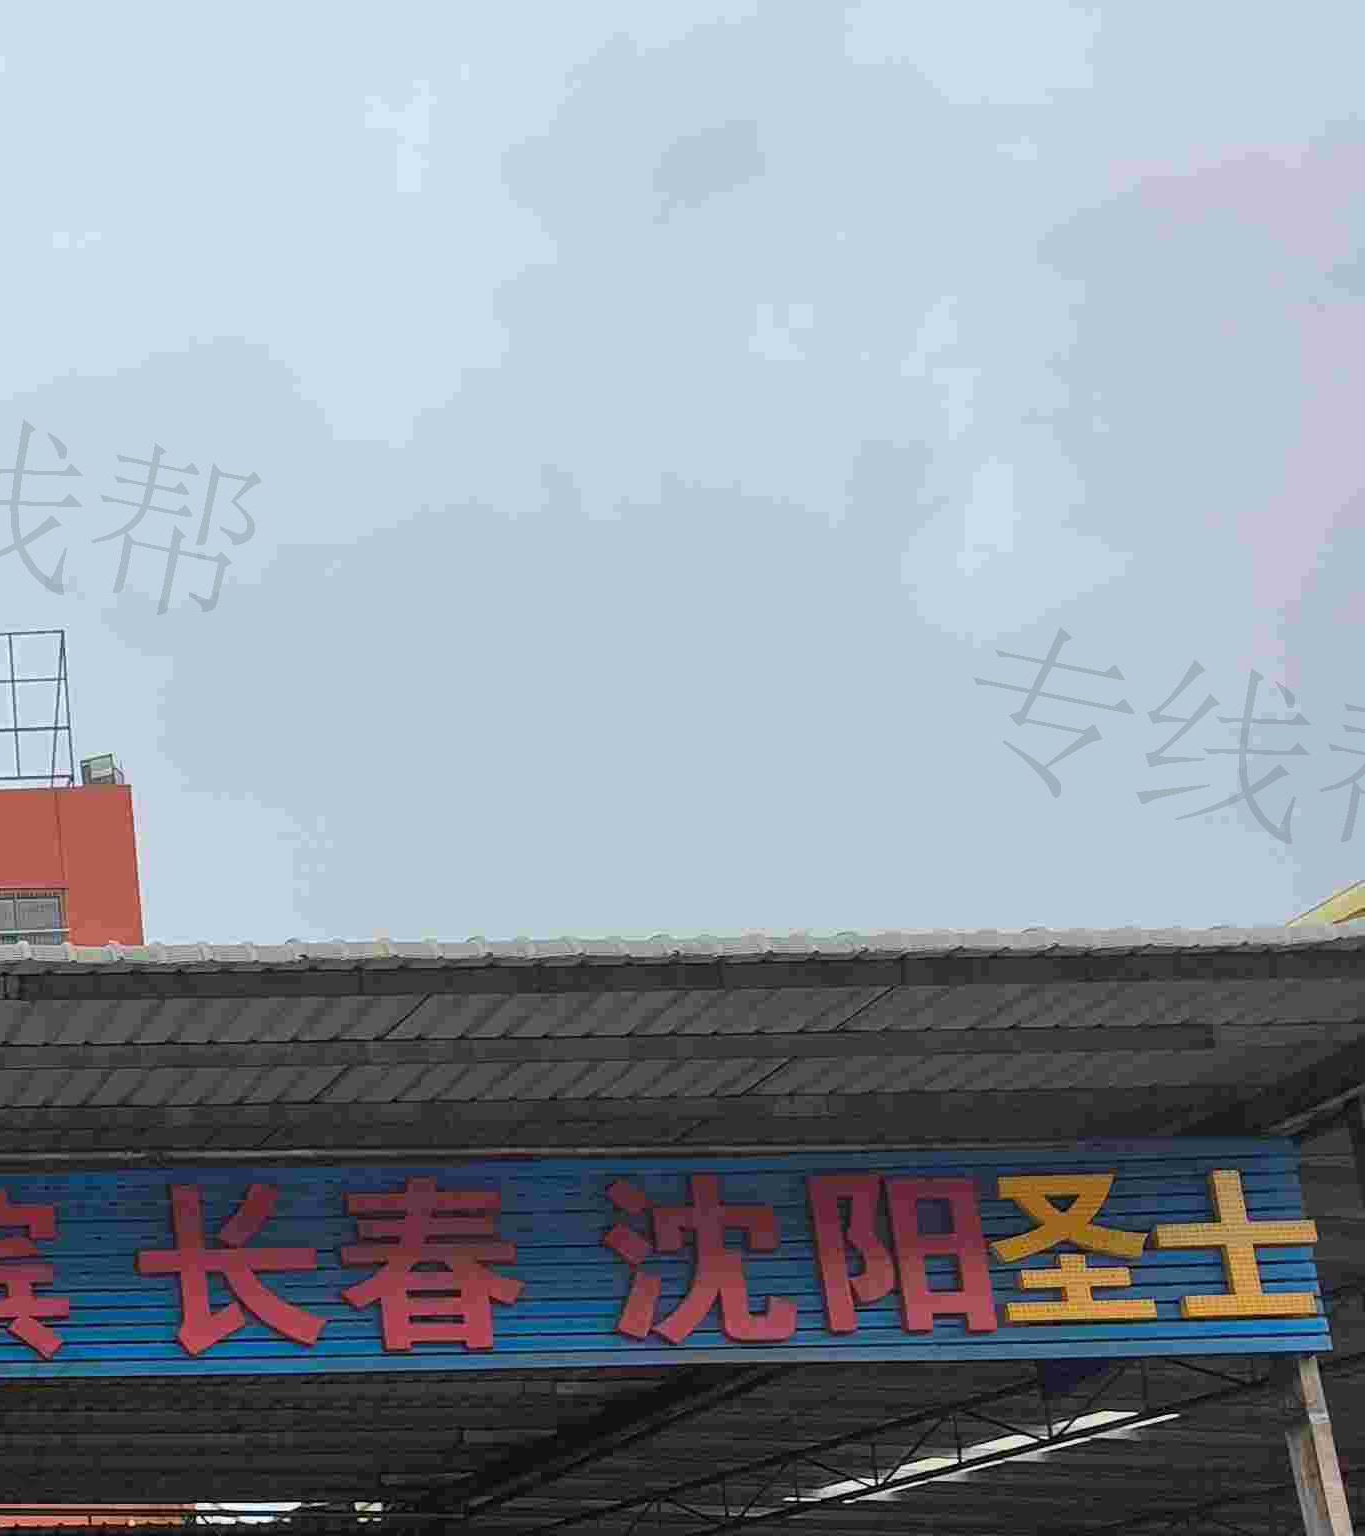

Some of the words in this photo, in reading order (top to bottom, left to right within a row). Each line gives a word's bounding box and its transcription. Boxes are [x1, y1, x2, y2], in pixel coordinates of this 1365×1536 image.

[135, 1179, 525, 1355] 长春
[603, 1174, 998, 1344] 沈阳
[991, 1168, 1318, 1322] 圣士
